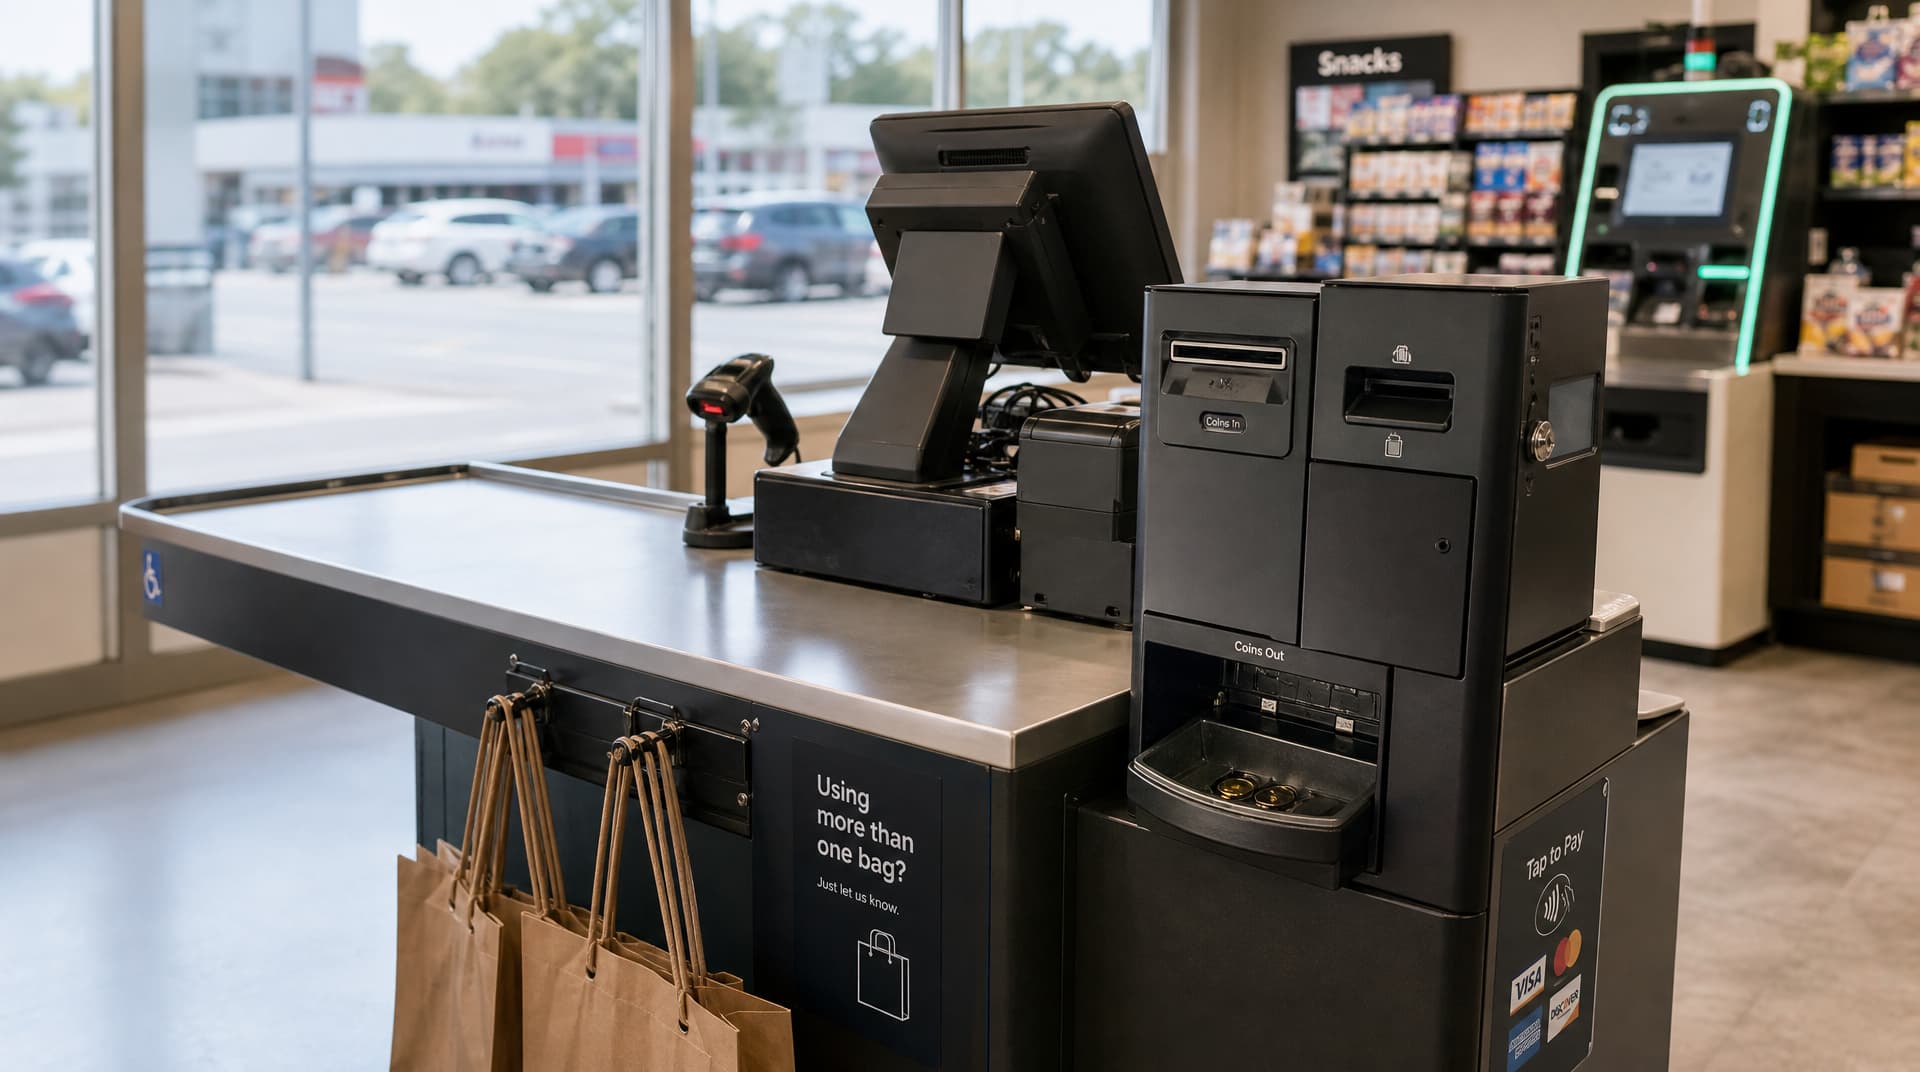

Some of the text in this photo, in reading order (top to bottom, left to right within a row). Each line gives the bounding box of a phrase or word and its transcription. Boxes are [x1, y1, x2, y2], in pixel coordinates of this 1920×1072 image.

[1318, 46, 1402, 77] Snacks
[1206, 416, 1230, 428] Coins
[1234, 640, 1285, 661] Coins Out
[817, 774, 870, 815] Using
[817, 808, 914, 854] more than
[817, 839, 907, 884] one bag?
[1526, 829, 1585, 881] Tap to Pay
[817, 876, 900, 916] Just let us know.
[1515, 965, 1542, 1001] VISA
